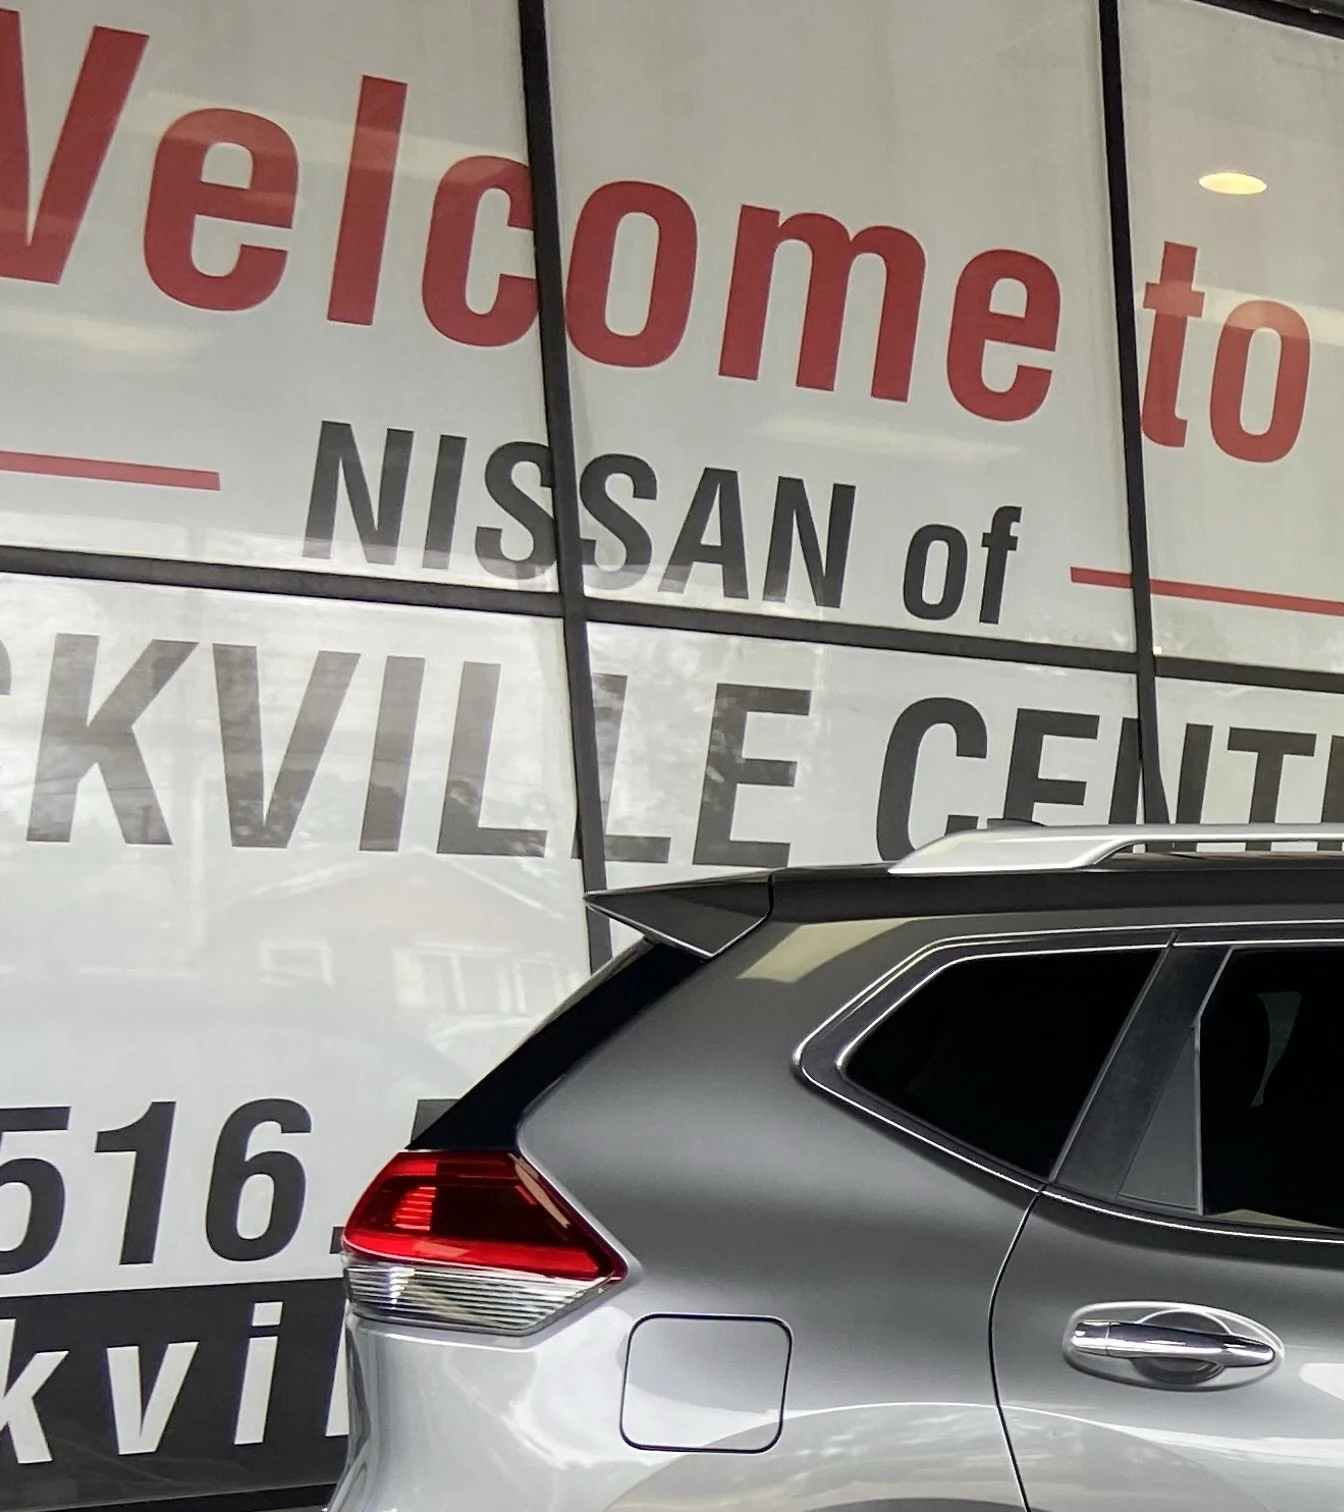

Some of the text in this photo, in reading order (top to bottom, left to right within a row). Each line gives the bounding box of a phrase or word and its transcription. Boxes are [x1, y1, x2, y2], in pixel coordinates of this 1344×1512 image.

[1141, 241, 1311, 463] to
[302, 420, 1022, 625] NISSAN of
[0, 633, 812, 868] KVILLE
